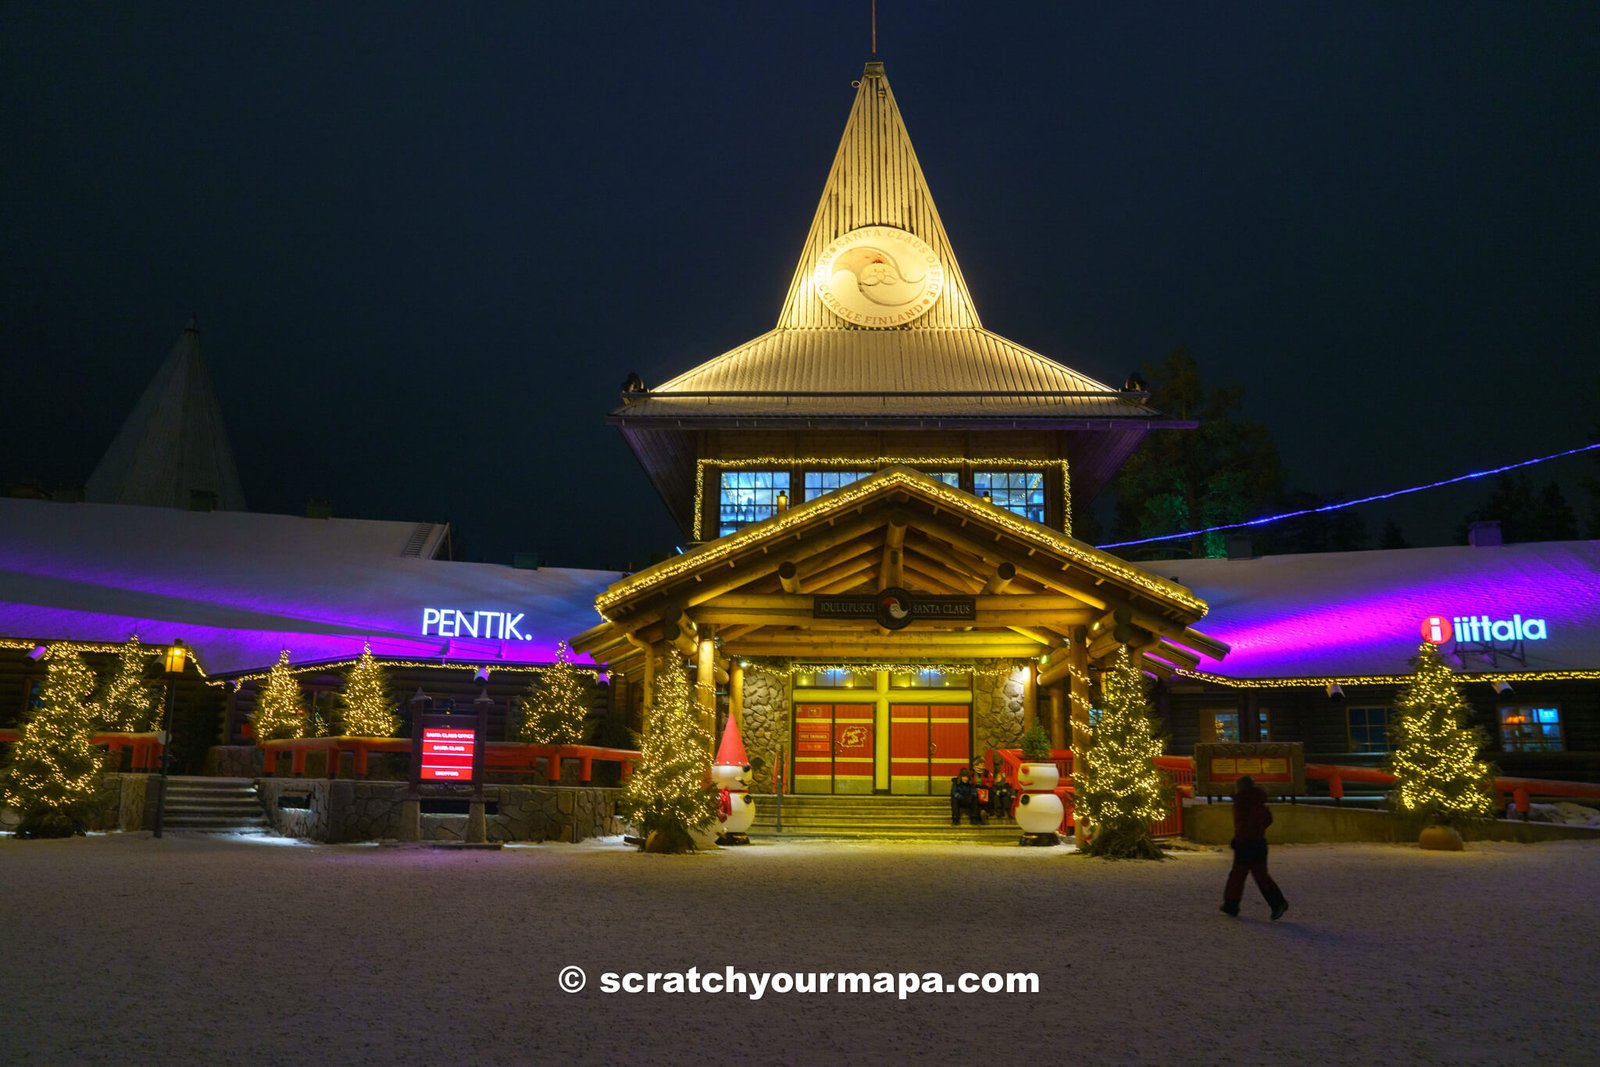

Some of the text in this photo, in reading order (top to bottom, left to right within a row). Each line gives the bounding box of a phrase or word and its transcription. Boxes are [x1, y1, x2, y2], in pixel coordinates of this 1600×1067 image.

[835, 229, 881, 248] SANTA
[886, 230, 928, 254] CLAUS
[823, 291, 862, 323] CIRCLE
[864, 304, 924, 326] FINLAND
[912, 604, 940, 614] SANTA
[942, 604, 970, 615] CLAUS
[1453, 614, 1547, 642] iittala
